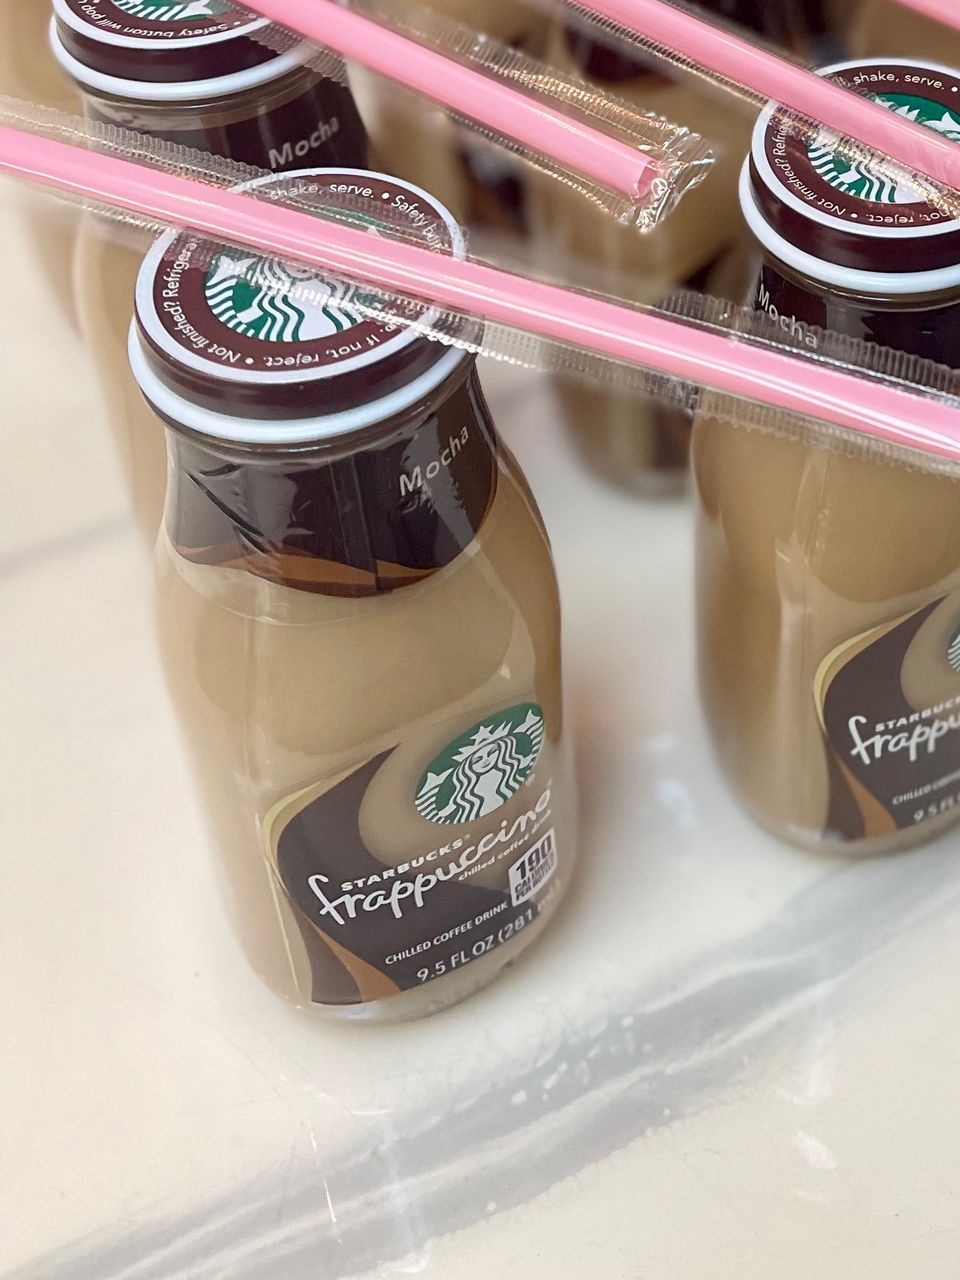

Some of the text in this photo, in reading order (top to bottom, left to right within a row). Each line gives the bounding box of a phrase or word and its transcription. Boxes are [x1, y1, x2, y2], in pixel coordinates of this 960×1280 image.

[81, 4, 106, 20] pop
[95, 18, 122, 30] will
[123, 25, 174, 38] button
[178, 23, 228, 37] Safety
[852, 70, 945, 90] shake, serve.
[268, 116, 339, 169] Mocha
[269, 182, 375, 200] shake, serve.
[774, 158, 817, 200] finished?
[391, 195, 429, 227] Safety
[817, 198, 847, 216] Not
[865, 213, 915, 224] reject.
[163, 301, 209, 349] finished?
[757, 283, 818, 349] Mocha
[207, 341, 241, 363] Not
[326, 341, 362, 358] not,
[366, 334, 380, 347] If
[263, 352, 320, 366] reject.
[399, 426, 469, 496] Mocha
[307, 788, 551, 926] frappuccino
[340, 837, 464, 892] STARBUCKS
[458, 855, 496, 881] chilled
[515, 834, 552, 880] 190
[384, 900, 509, 965] CHILLED COFFEE DRINK
[416, 907, 533, 982] 9.5 FL OZ (281
